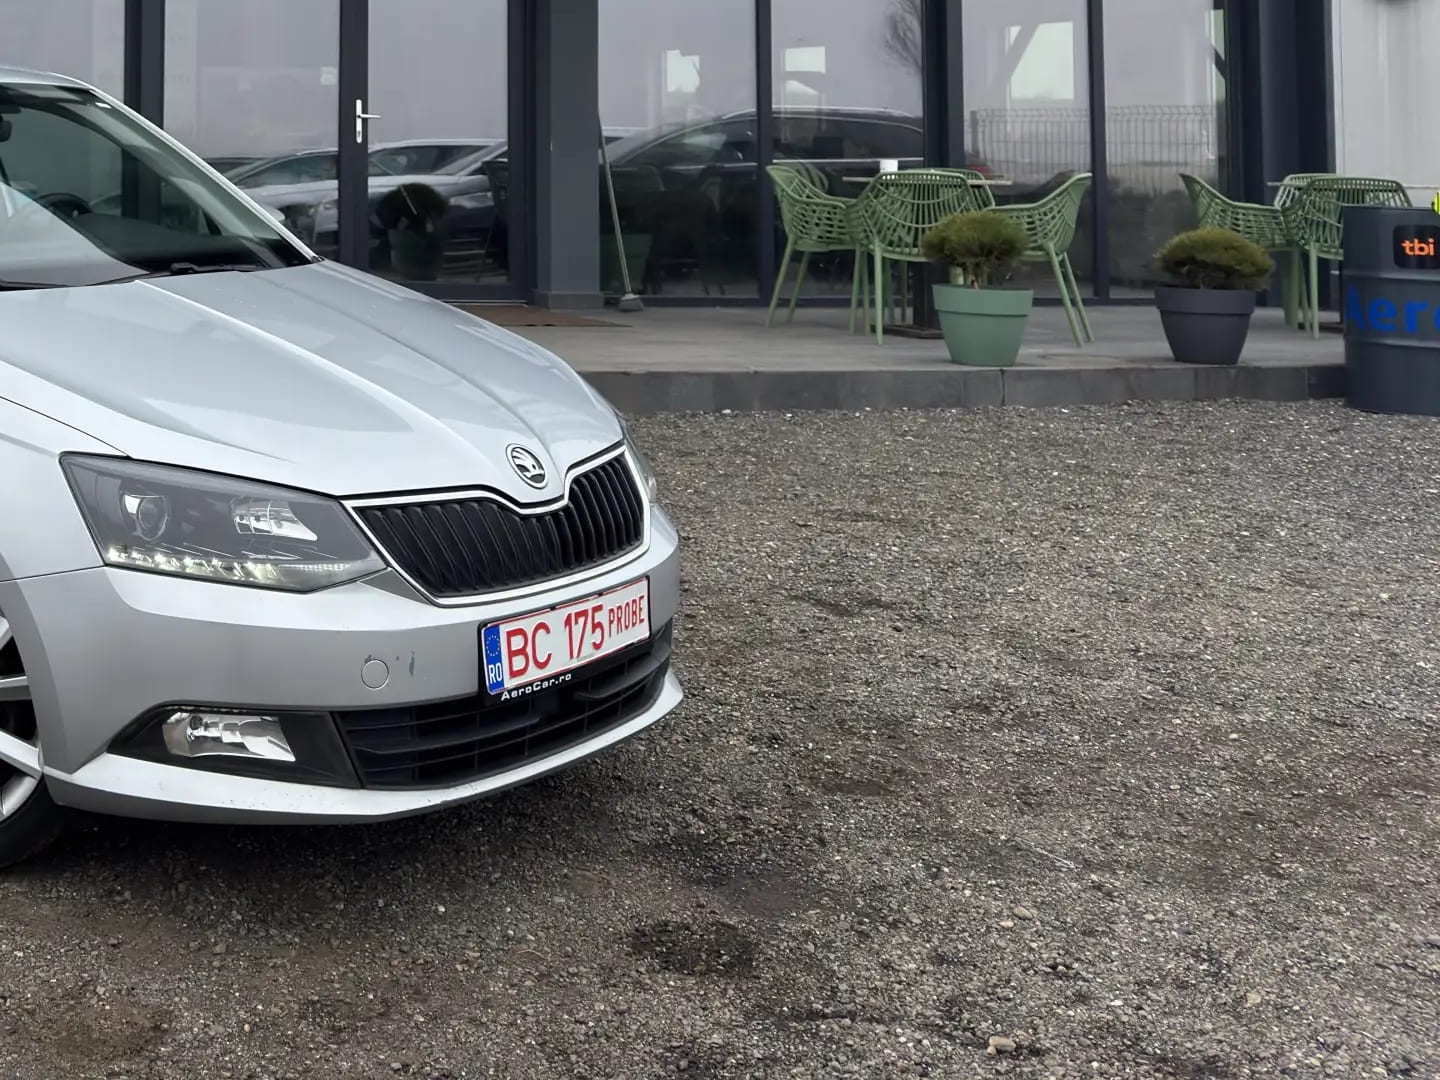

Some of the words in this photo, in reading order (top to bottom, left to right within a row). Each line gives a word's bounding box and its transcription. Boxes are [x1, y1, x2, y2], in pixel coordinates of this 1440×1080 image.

[1401, 238, 1435, 256] tbi
[1344, 283, 1440, 334] Aer
[506, 621, 552, 678] BC
[564, 604, 604, 660] 175
[608, 595, 646, 638] PROBE
[488, 662, 504, 685] RO
[500, 673, 572, 702] AeroCar.ro
